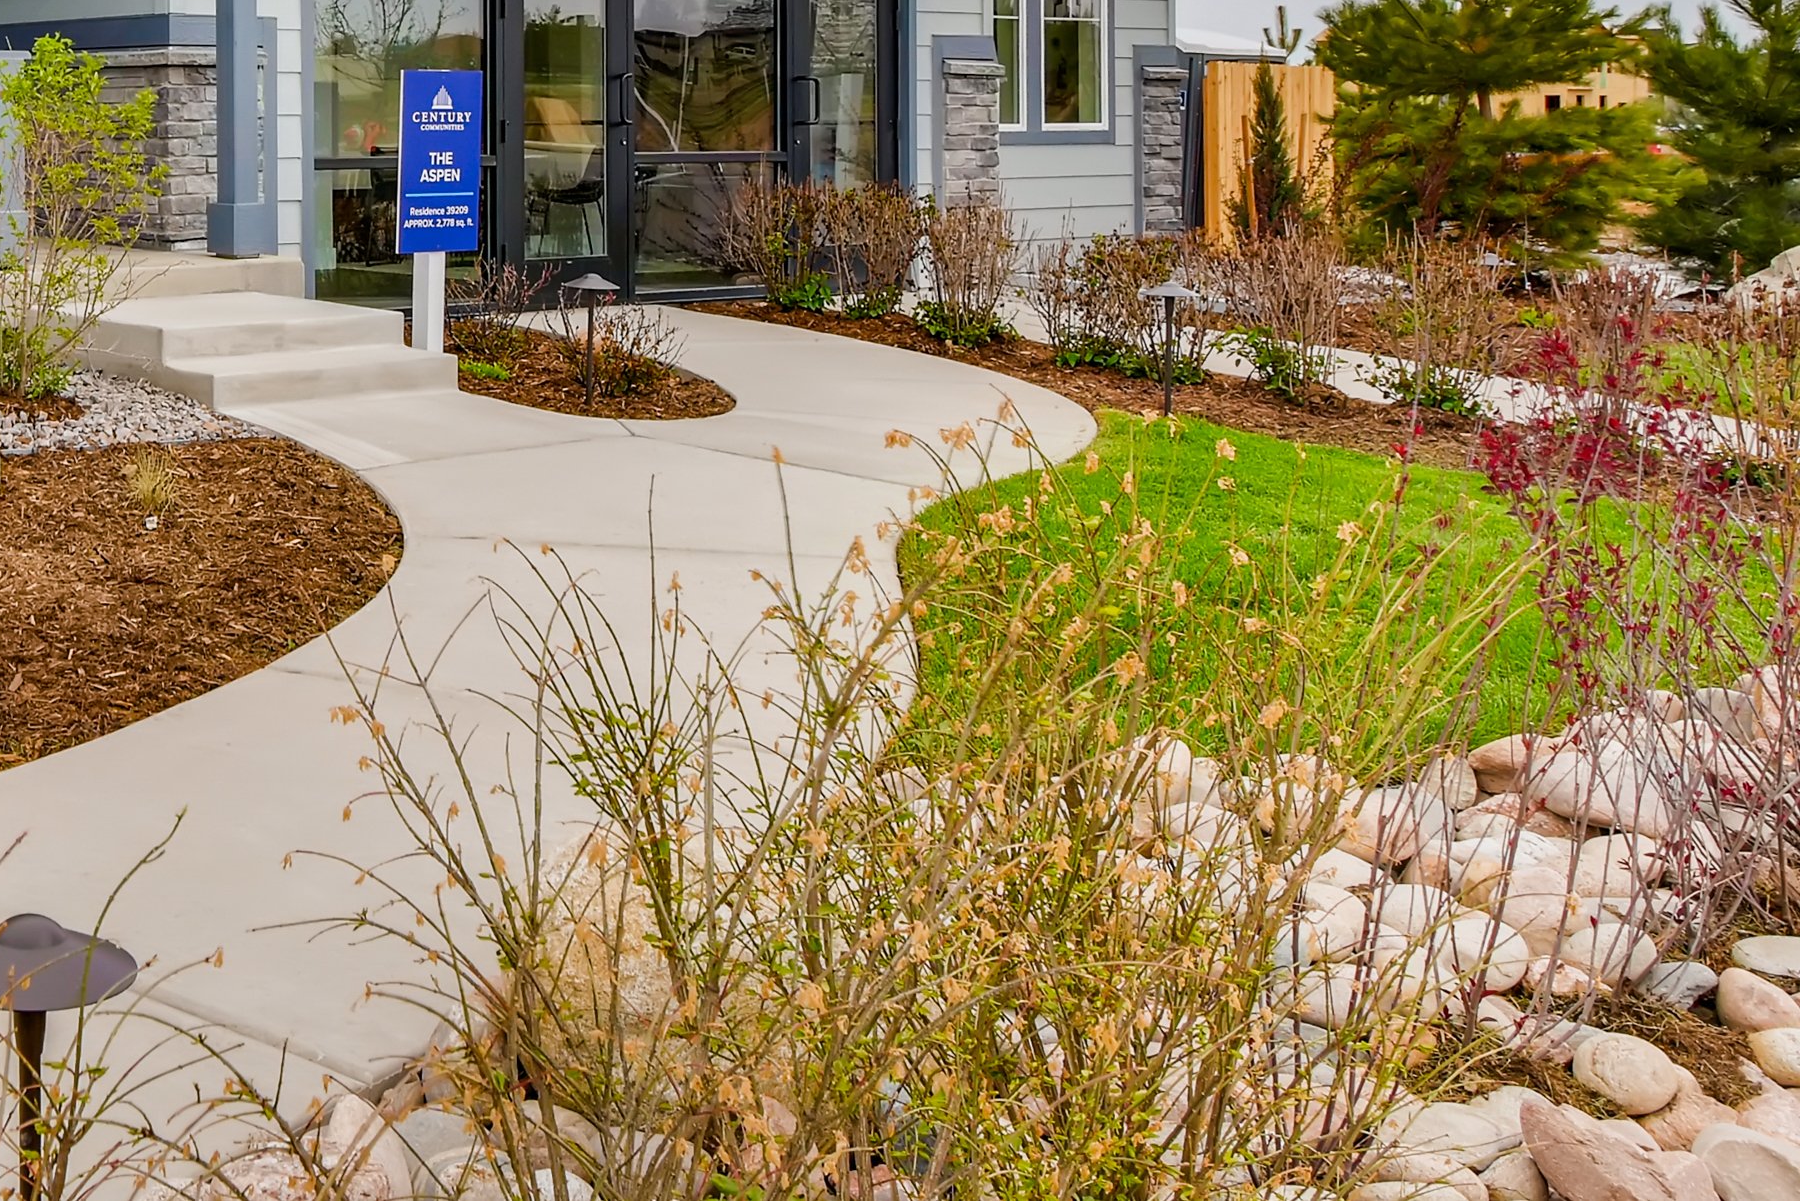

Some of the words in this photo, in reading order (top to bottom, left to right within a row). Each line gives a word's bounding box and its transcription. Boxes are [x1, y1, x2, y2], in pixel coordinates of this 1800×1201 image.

[412, 111, 472, 123] CENTURY
[429, 152, 454, 166] THE
[420, 169, 461, 183] ASPEN
[410, 207, 446, 216] Residence
[446, 205, 469, 215] 39209
